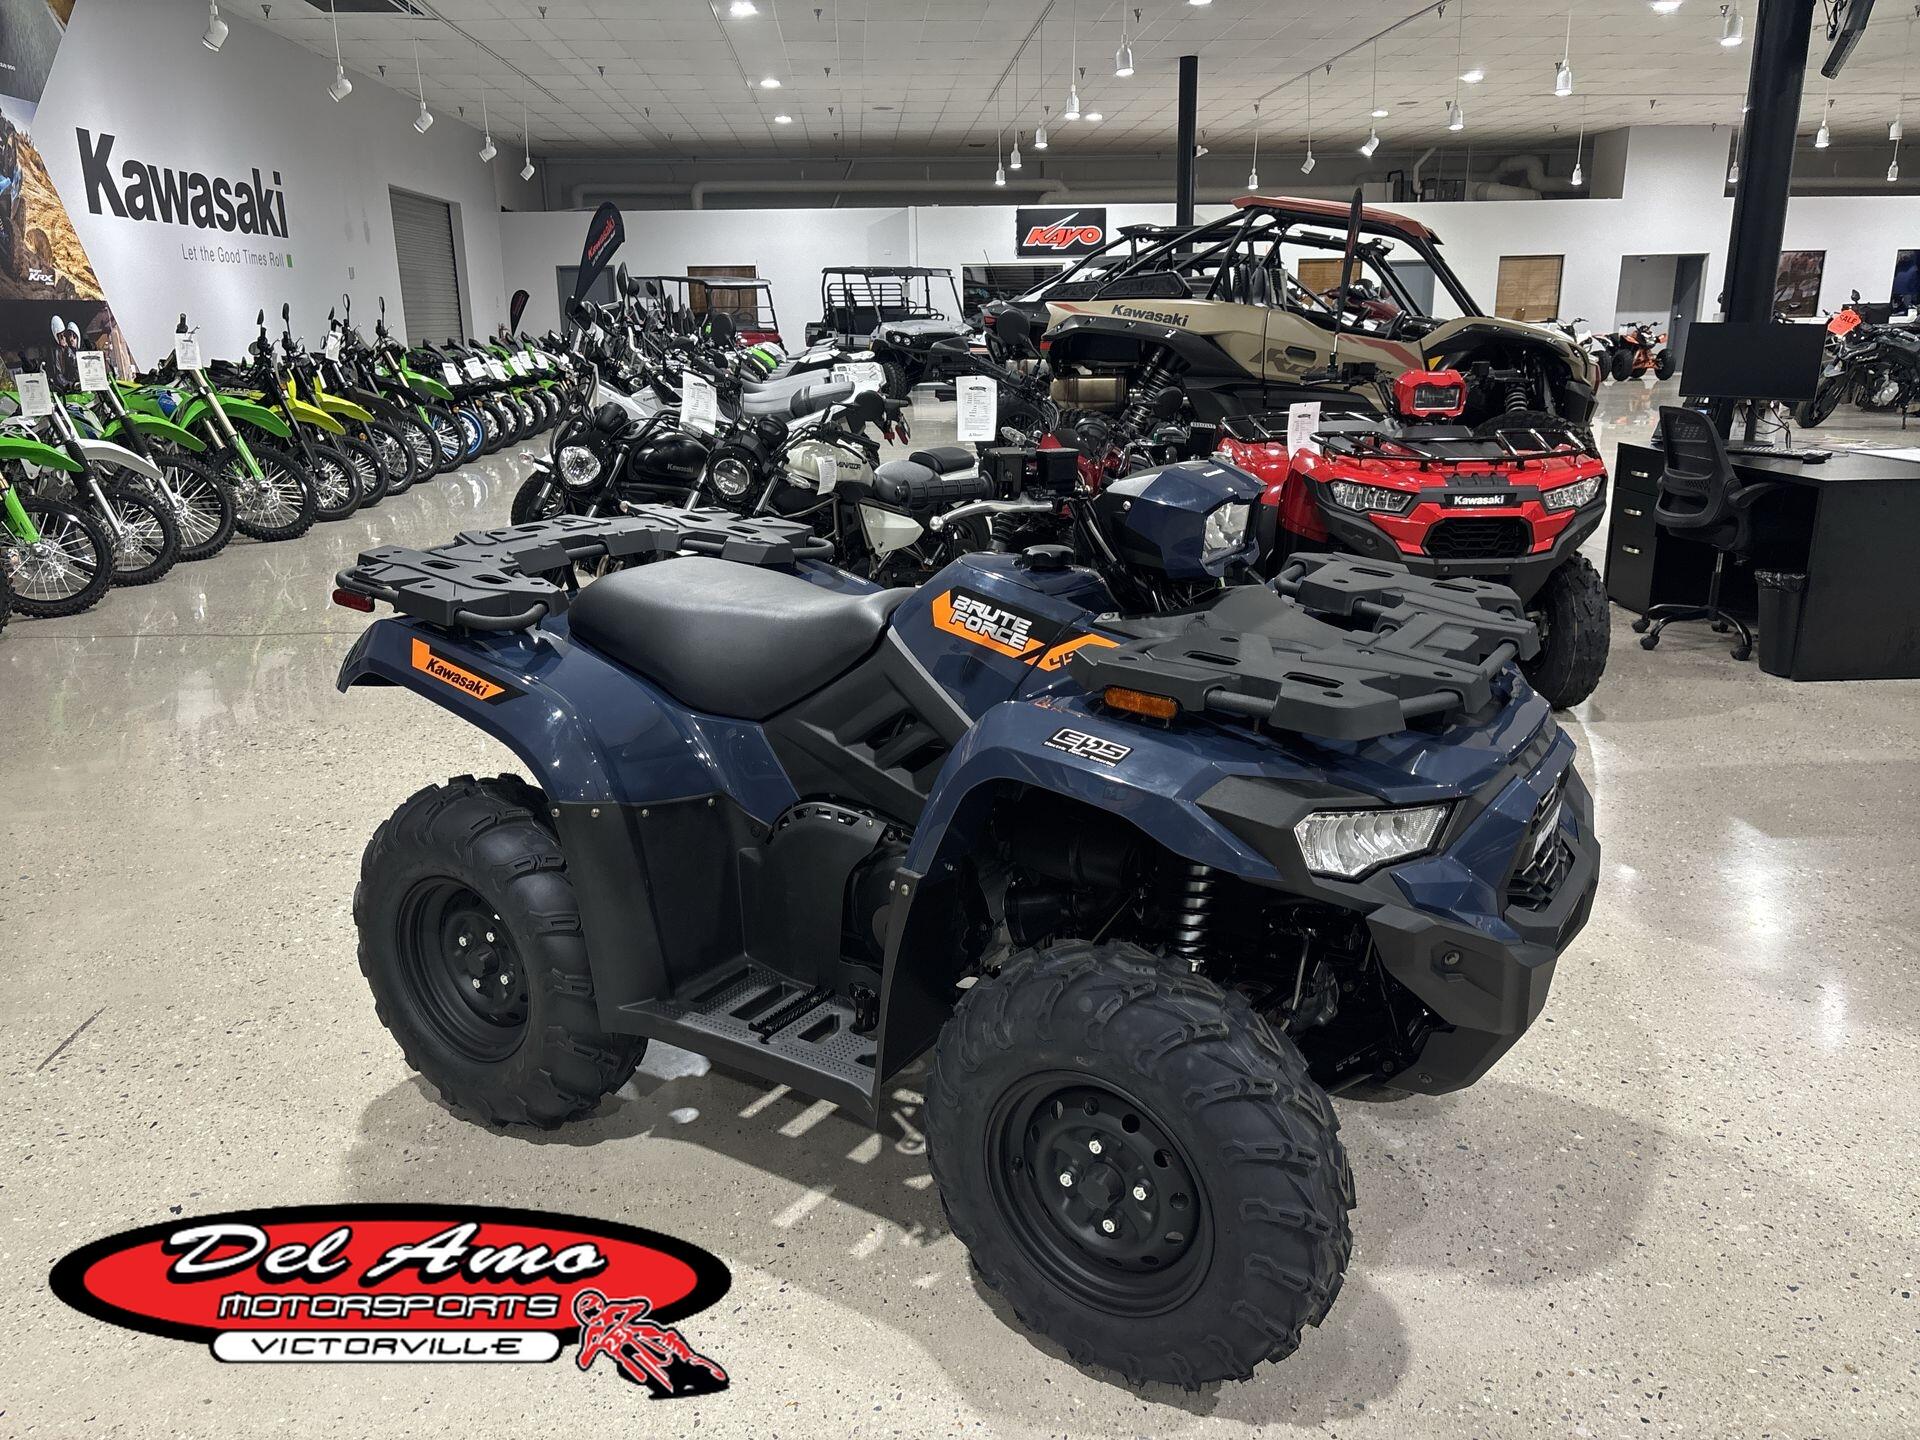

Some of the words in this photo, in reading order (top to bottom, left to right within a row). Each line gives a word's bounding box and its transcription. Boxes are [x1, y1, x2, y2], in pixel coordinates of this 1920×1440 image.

[75, 126, 289, 239] Kawasaki
[1023, 212, 1103, 250] KAYO
[181, 243, 198, 261] Let
[199, 246, 215, 262] the
[217, 246, 241, 264] Good
[242, 249, 267, 266] Times
[268, 251, 285, 268] Roll
[28, 272, 54, 282] KRX
[1111, 304, 1190, 328] Kawasaki
[1840, 314, 1858, 325] SALE
[666, 462, 694, 473] Kawasaki
[1453, 494, 1505, 505] Kawasaki
[952, 594, 1033, 633] BRUTE
[949, 609, 1029, 651] FORCE
[425, 657, 490, 697] Kawasaki
[1052, 728, 1131, 760] EPS
